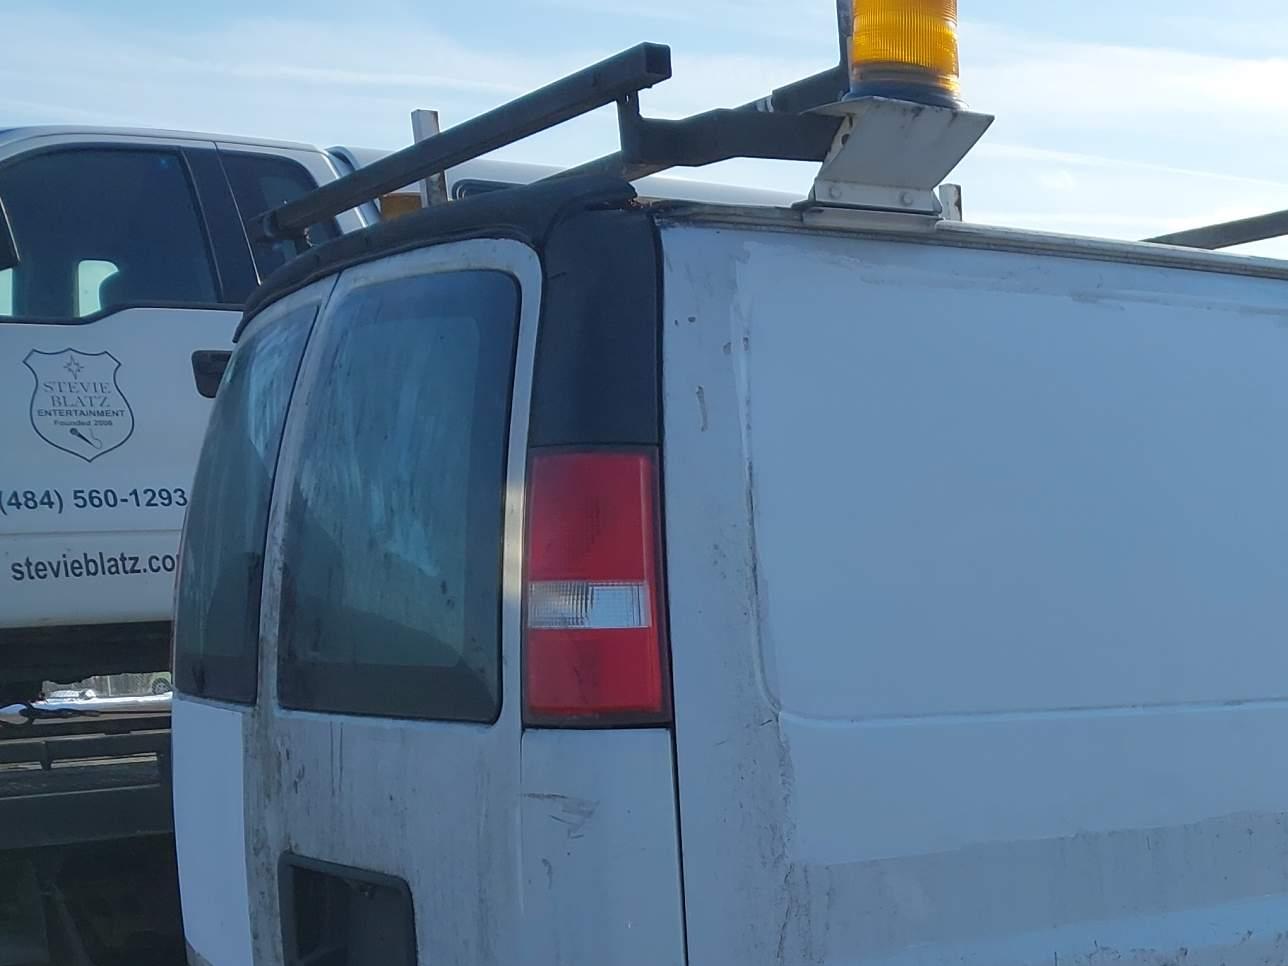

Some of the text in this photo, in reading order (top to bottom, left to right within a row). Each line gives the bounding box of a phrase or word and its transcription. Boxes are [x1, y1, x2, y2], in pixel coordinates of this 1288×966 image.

[43, 381, 112, 394] STEVIE
[51, 395, 111, 408] BLATZ
[37, 408, 126, 418] ENTERTAINMENT
[53, 419, 91, 427] Founded
[73, 487, 188, 508] 560-1293
[11, 551, 180, 581] stevieblatz.co
